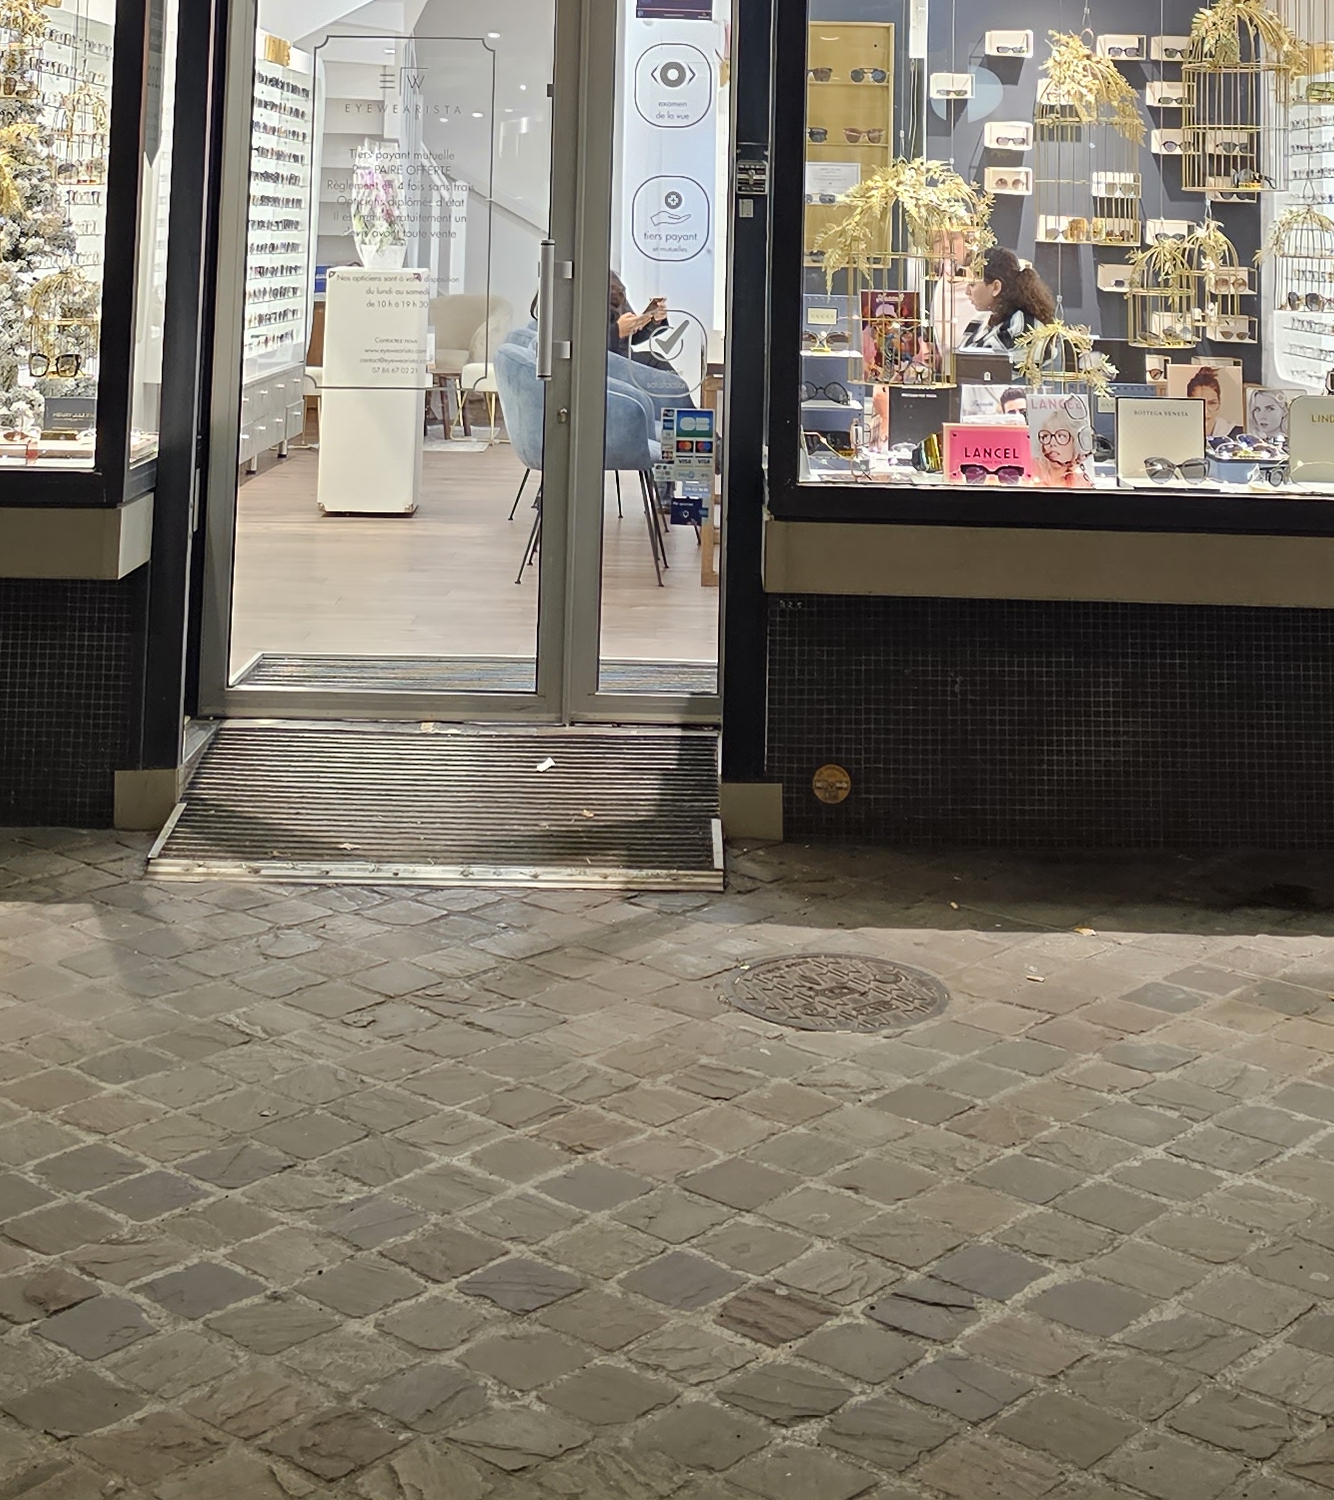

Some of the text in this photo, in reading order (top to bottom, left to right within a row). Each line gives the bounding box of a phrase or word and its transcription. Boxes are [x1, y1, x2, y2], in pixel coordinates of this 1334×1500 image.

[345, 104, 462, 115] EYEWEARISTA
[349, 149, 455, 162] Tiers payant mutuelle
[374, 164, 403, 175] PAIRE
[406, 165, 451, 176] OFFERTE
[327, 179, 379, 192] Règlement
[397, 180, 404, 190] 4
[408, 180, 425, 191] fois
[428, 183, 450, 192] sans
[452, 181, 475, 192] frais
[336, 195, 386, 208] Opticiens
[435, 197, 465, 207] d'état
[455, 215, 467, 223] un
[403, 228, 427, 238] toute
[431, 229, 456, 238] vente
[644, 232, 697, 243] tiers payant
[337, 274, 350, 282] Nos
[352, 274, 382, 283] opticiens
[424, 275, 460, 284] disposition
[376, 287, 393, 295] lundi
[406, 288, 430, 296] samedi
[377, 300, 386, 308] 10
[388, 300, 393, 308] h
[402, 300, 411, 308] 19
[412, 300, 417, 308] h
[418, 301, 429, 309] 30
[1031, 398, 1082, 410] LANCEL
[964, 447, 1019, 459] LANCEL
